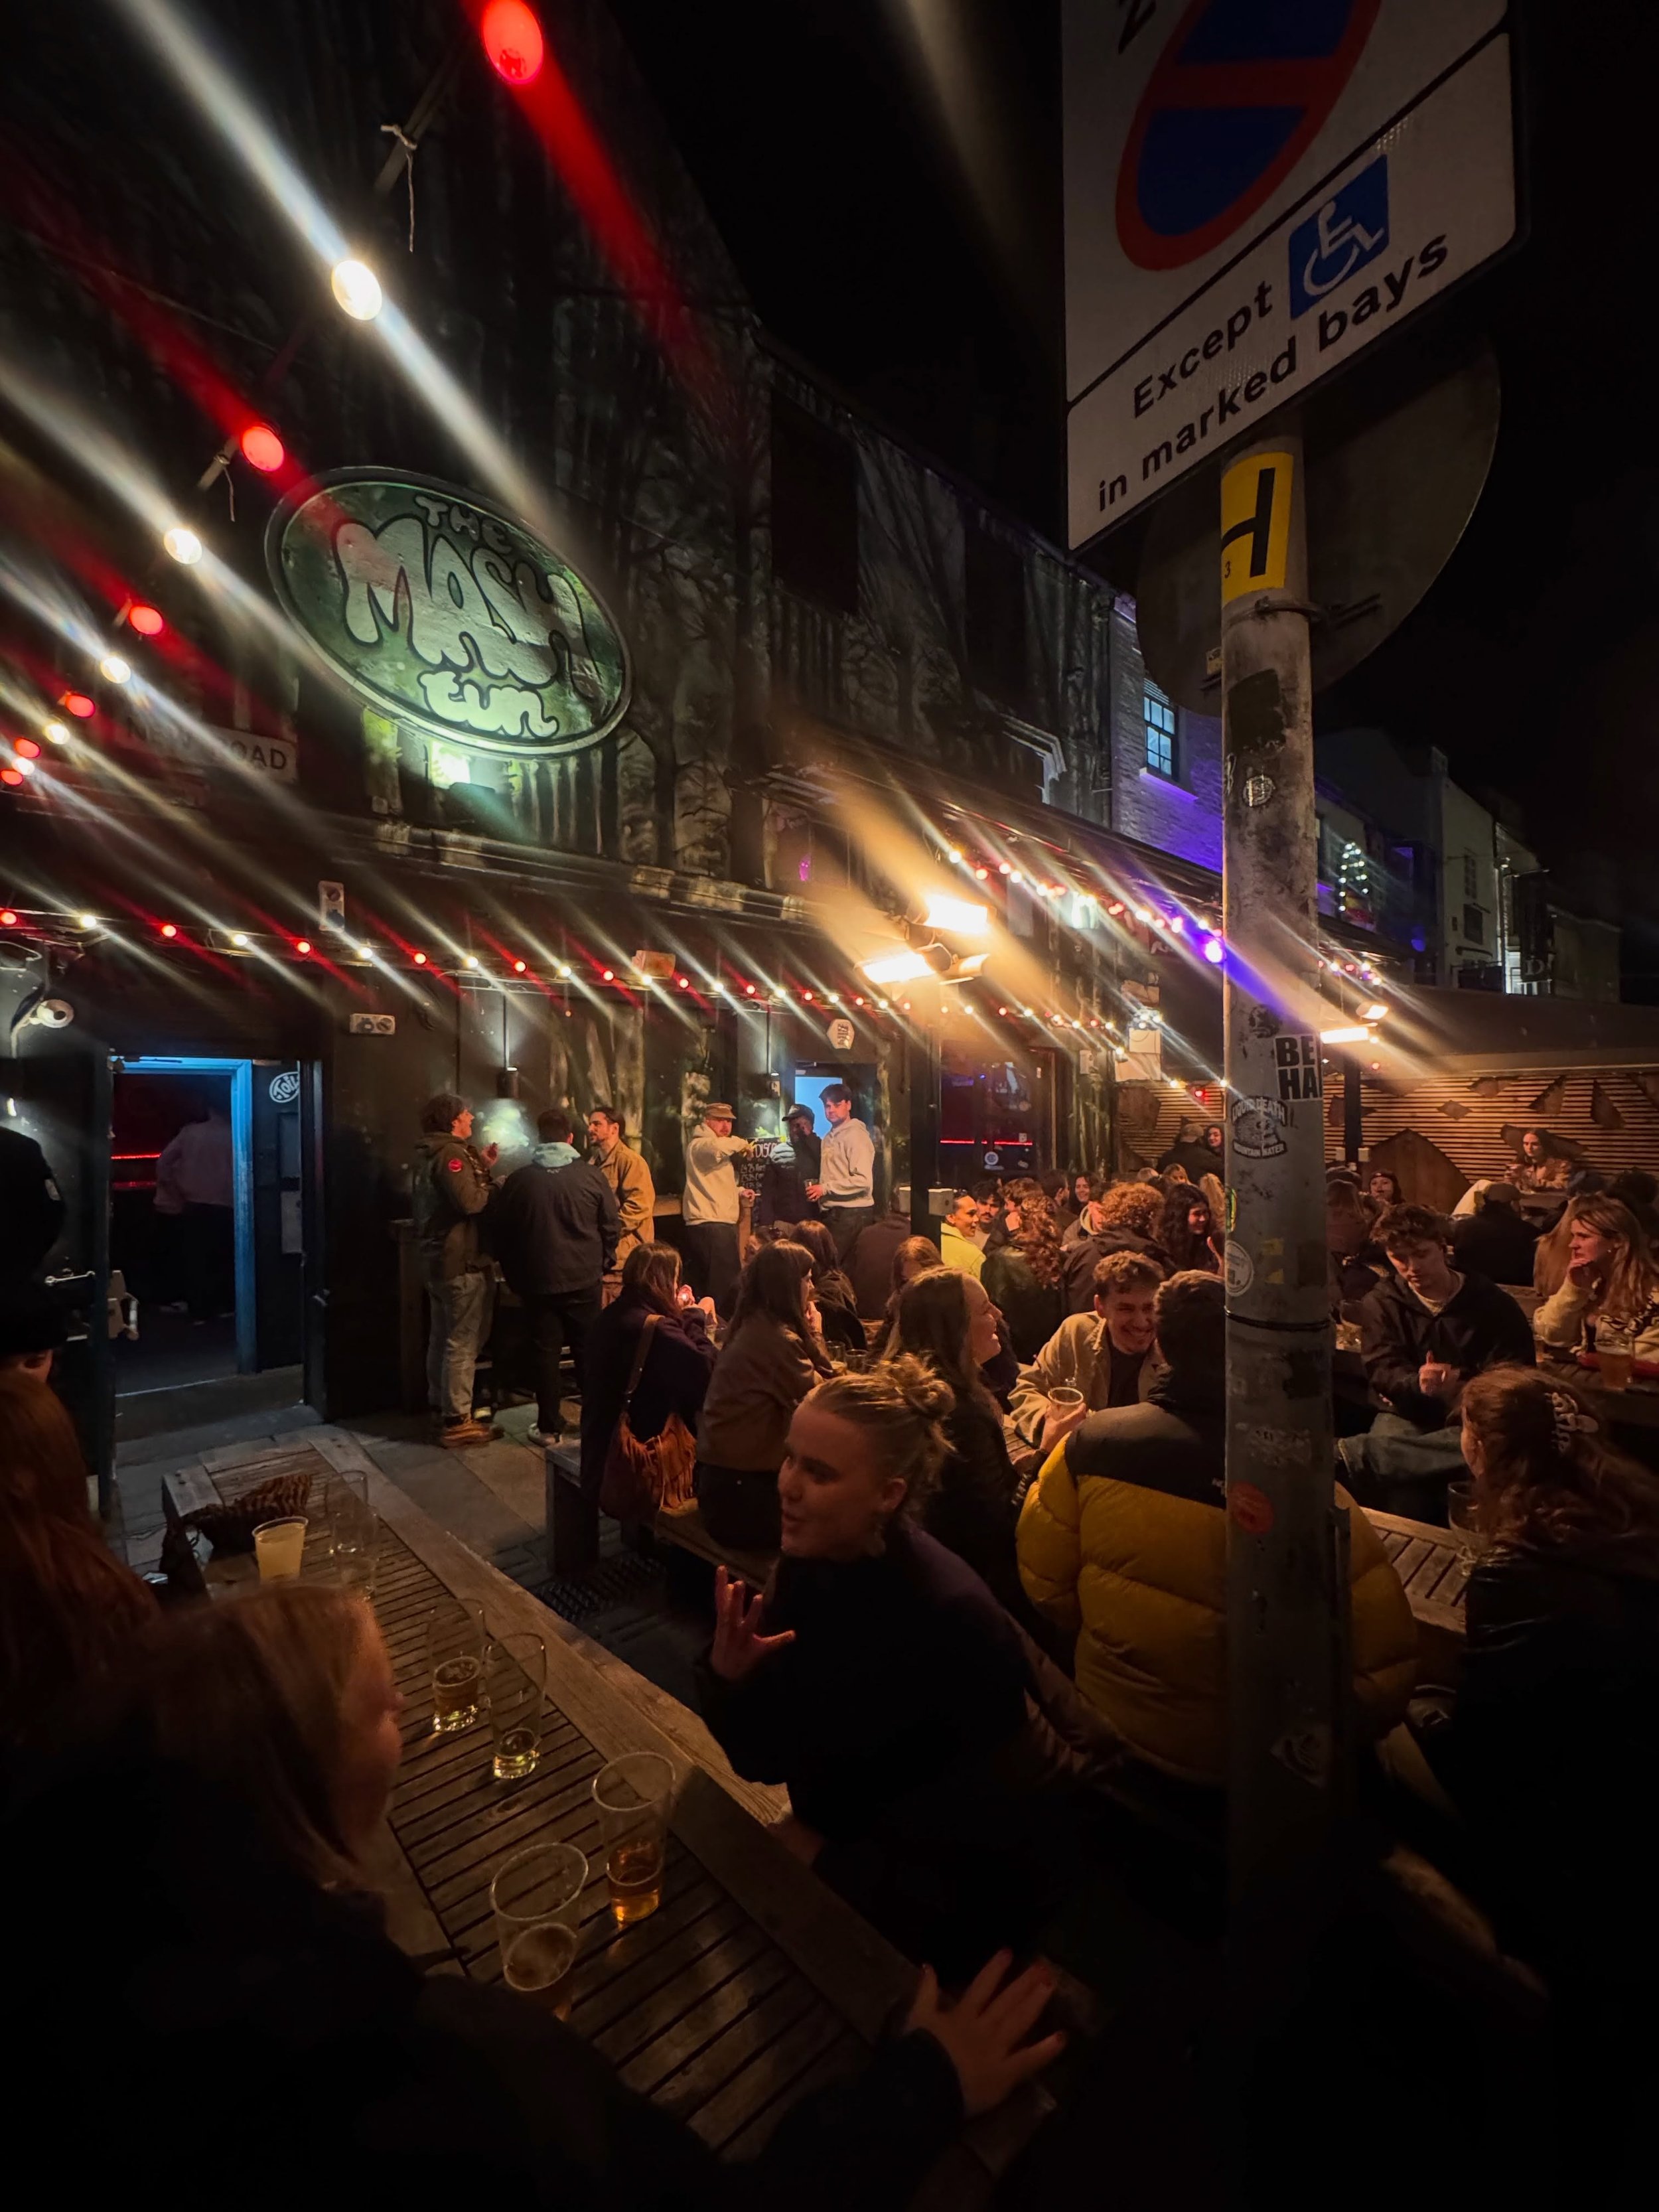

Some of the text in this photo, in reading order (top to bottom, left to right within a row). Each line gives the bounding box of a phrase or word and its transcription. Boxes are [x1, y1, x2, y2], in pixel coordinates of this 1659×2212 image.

[1099, 234, 1448, 512] in marked bays
[1133, 281, 1273, 418] Except
[414, 494, 514, 554] THE
[417, 669, 560, 739] TUN
